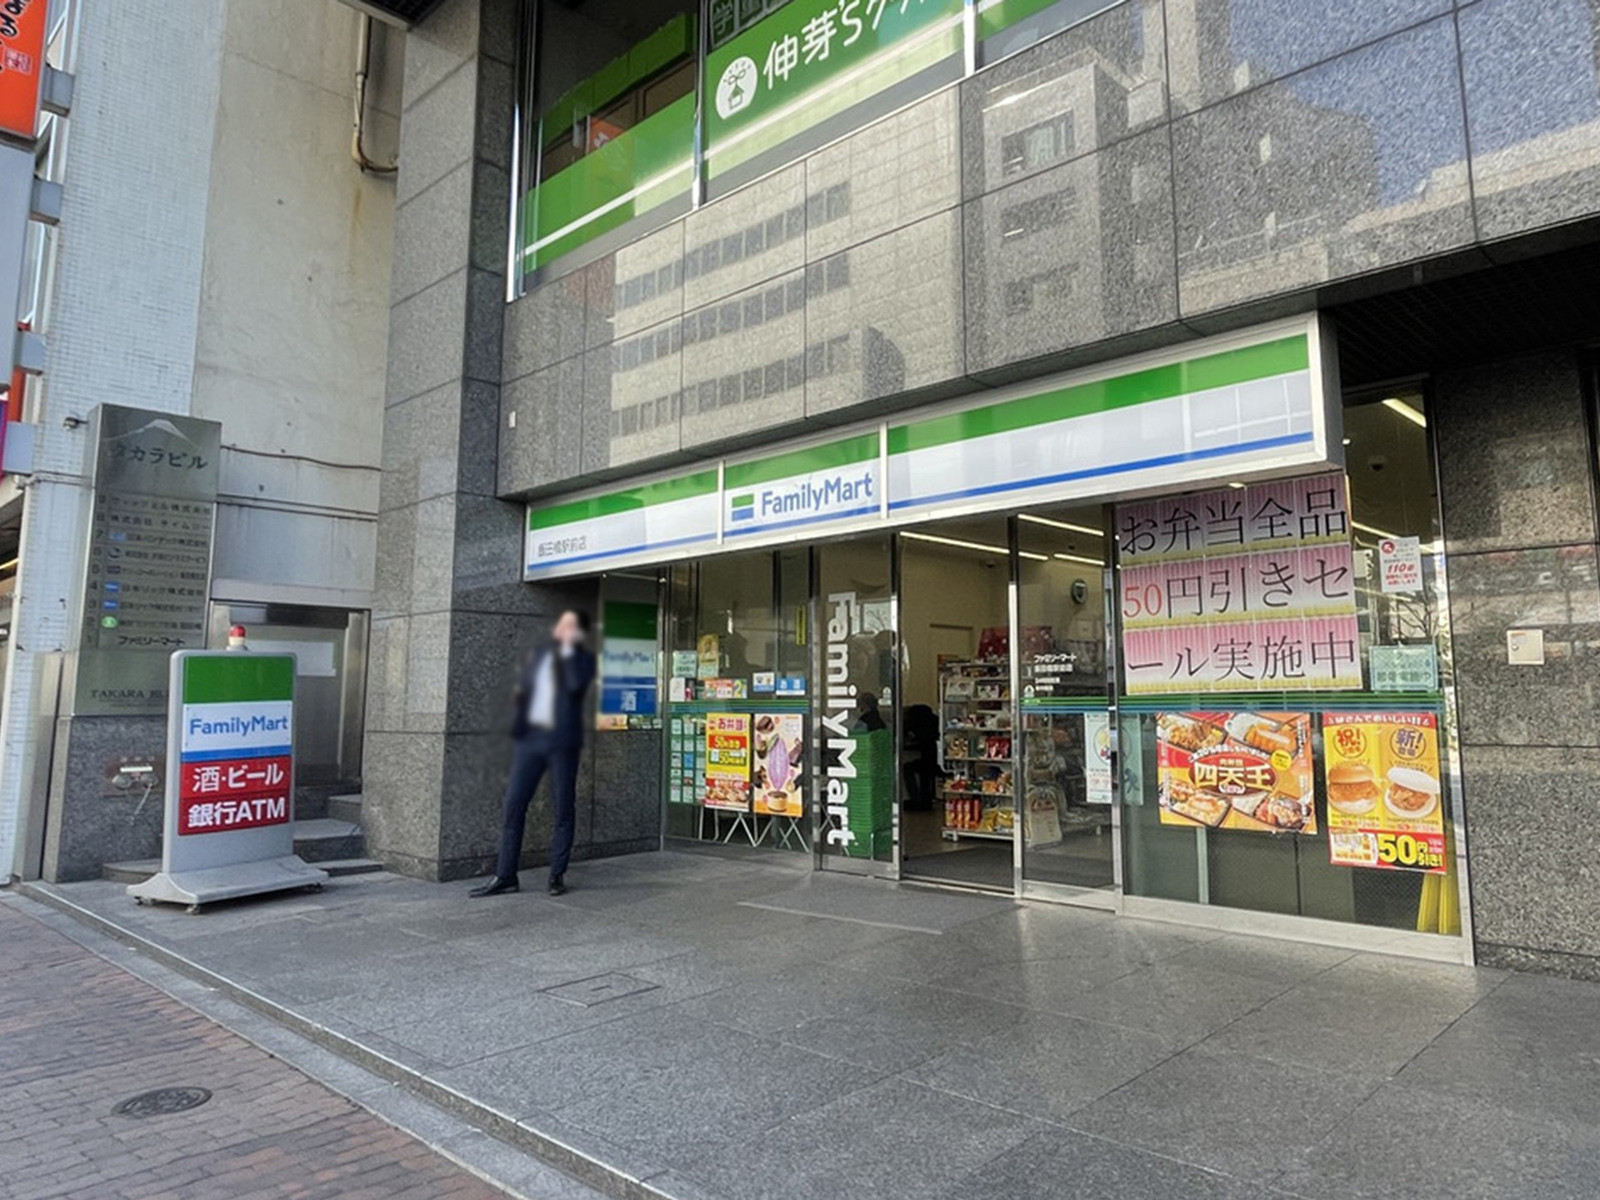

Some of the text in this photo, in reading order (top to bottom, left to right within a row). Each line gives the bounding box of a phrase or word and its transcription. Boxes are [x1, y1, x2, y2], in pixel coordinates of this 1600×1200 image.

[110, 442, 208, 470] タカラビル
[760, 471, 873, 518] FamilyMart
[1120, 487, 1347, 555] お弁当全品
[1122, 558, 1350, 620] 50円引きセ
[117, 635, 187, 648] ファミリーマート
[1127, 631, 1355, 682] ール実施中
[1033, 653, 1078, 664] ファミリーマート
[90, 689, 145, 699] TAKARA
[189, 715, 289, 737] FamilyMart
[822, 591, 859, 847] FamilyMart
[1194, 762, 1274, 792] 四天王
[187, 797, 286, 828] 銀行ATM
